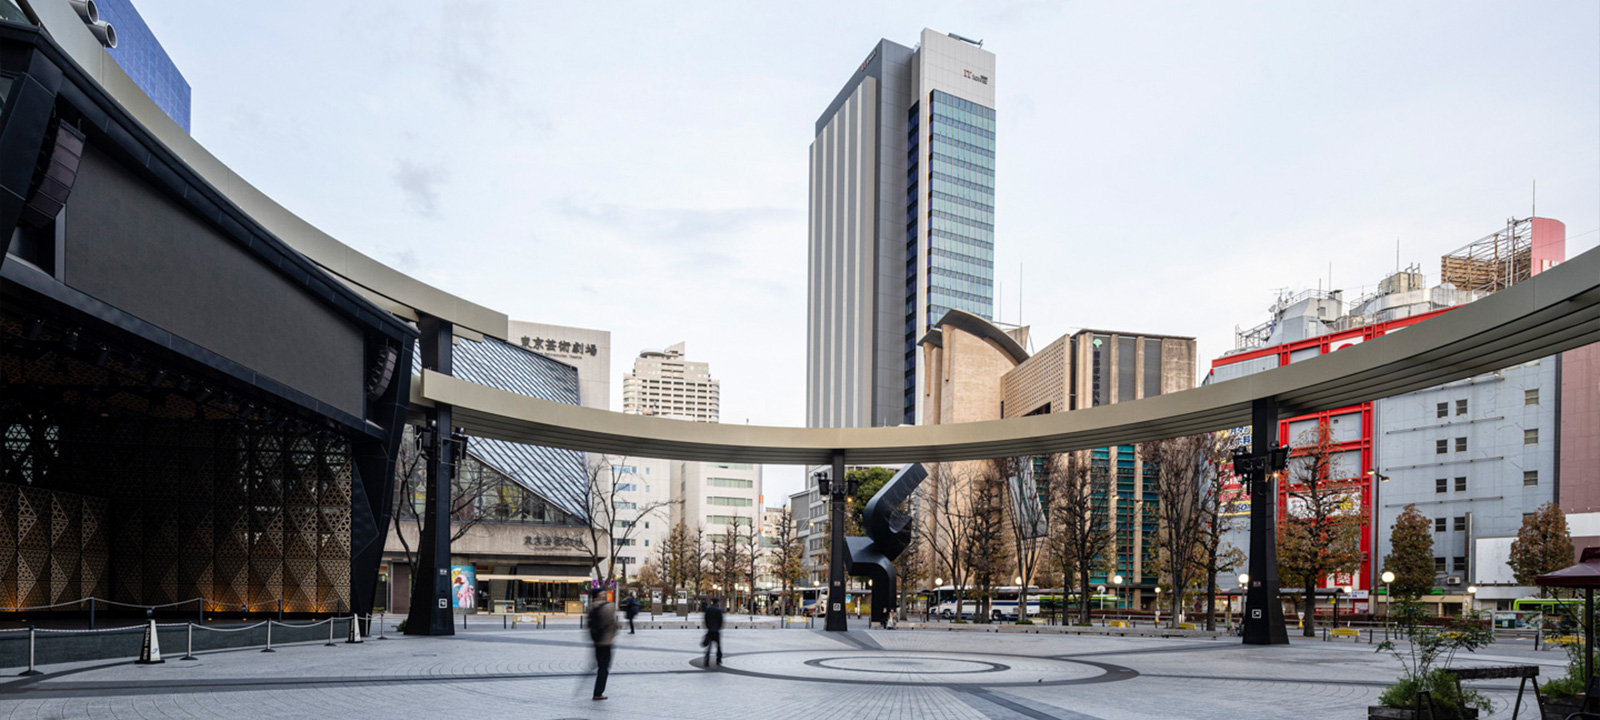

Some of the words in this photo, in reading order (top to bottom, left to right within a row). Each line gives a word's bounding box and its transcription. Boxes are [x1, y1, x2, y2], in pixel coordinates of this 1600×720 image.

[520, 335, 598, 357] 東京芸術劇場
